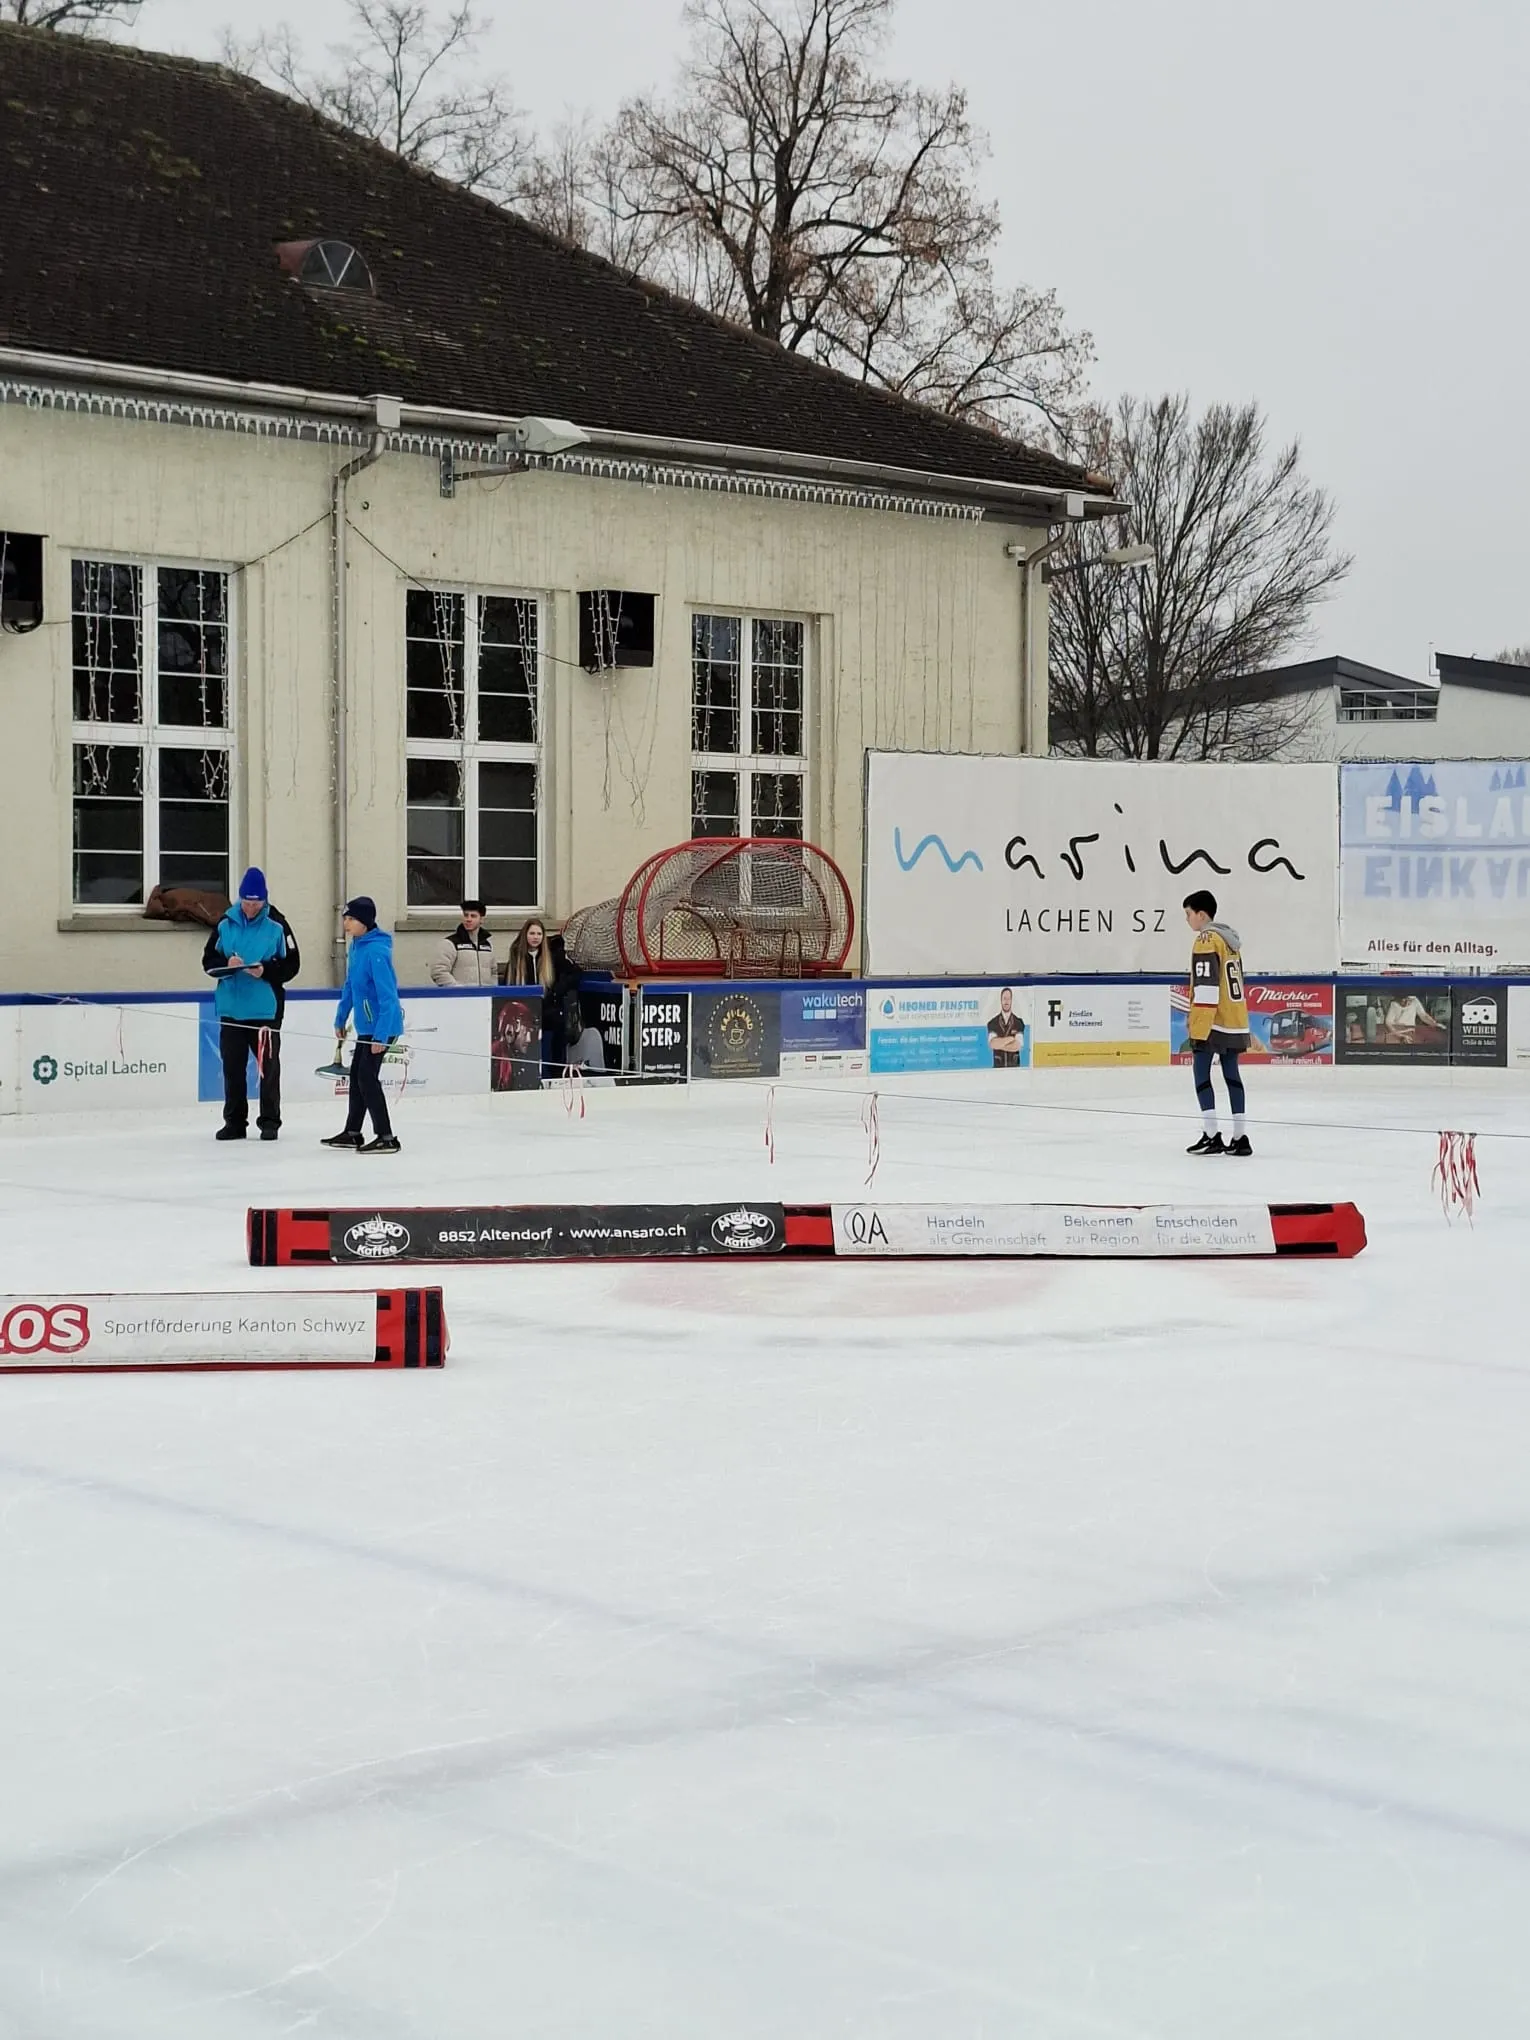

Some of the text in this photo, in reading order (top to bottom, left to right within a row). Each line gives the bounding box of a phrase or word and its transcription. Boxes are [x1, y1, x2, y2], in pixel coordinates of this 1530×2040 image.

[1365, 795, 1530, 839] EISLA
[894, 802, 1305, 880] marina
[1006, 909, 1166, 932] LACHEN SZ
[1368, 940, 1498, 956] Alles für den Alltag.
[1196, 961, 1211, 977] 61
[802, 992, 863, 1008] wakutech
[600, 1003, 617, 1022] DER
[64, 1059, 167, 1079] Spital Lachen
[352, 1220, 403, 1240] ANSARO
[718, 1211, 768, 1232] ANSARO
[927, 1215, 985, 1229] Handeln
[438, 1224, 687, 1243] 8852 Altendorf www.ansaro.ch
[724, 1236, 764, 1248] Kaffee
[929, 1232, 1047, 1246] als Gemeinschaft
[1065, 1234, 1139, 1248] zur Region
[1157, 1232, 1257, 1245] für die Zukunft
[356, 1244, 398, 1257] Kaffee
[0, 1304, 90, 1354] OS
[104, 1317, 366, 1336] Sportförderung Kanton Schwyz
